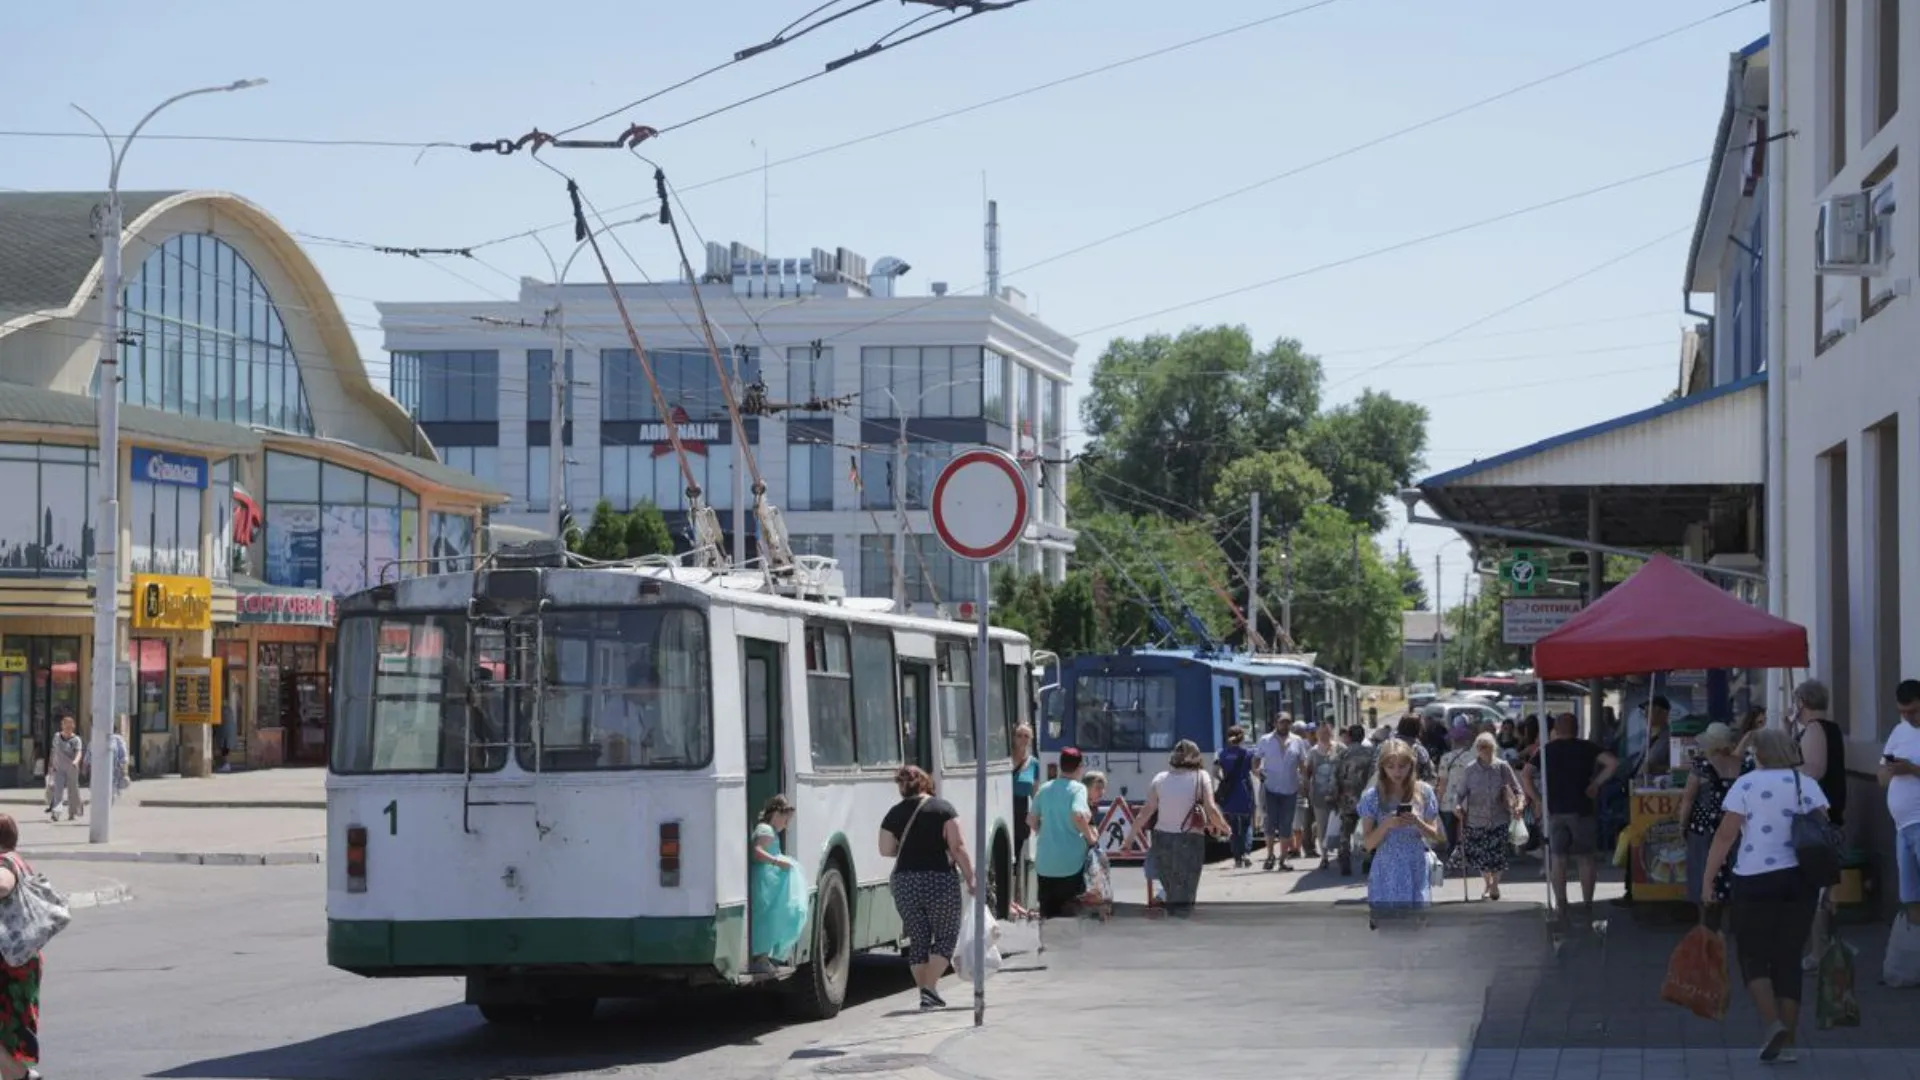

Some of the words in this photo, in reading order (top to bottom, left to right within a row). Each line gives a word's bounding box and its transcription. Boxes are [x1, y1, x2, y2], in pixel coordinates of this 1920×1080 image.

[640, 423, 719, 440] ADRNALIN
[1531, 603, 1580, 613] ОПТИКА
[383, 799, 397, 835] 1
